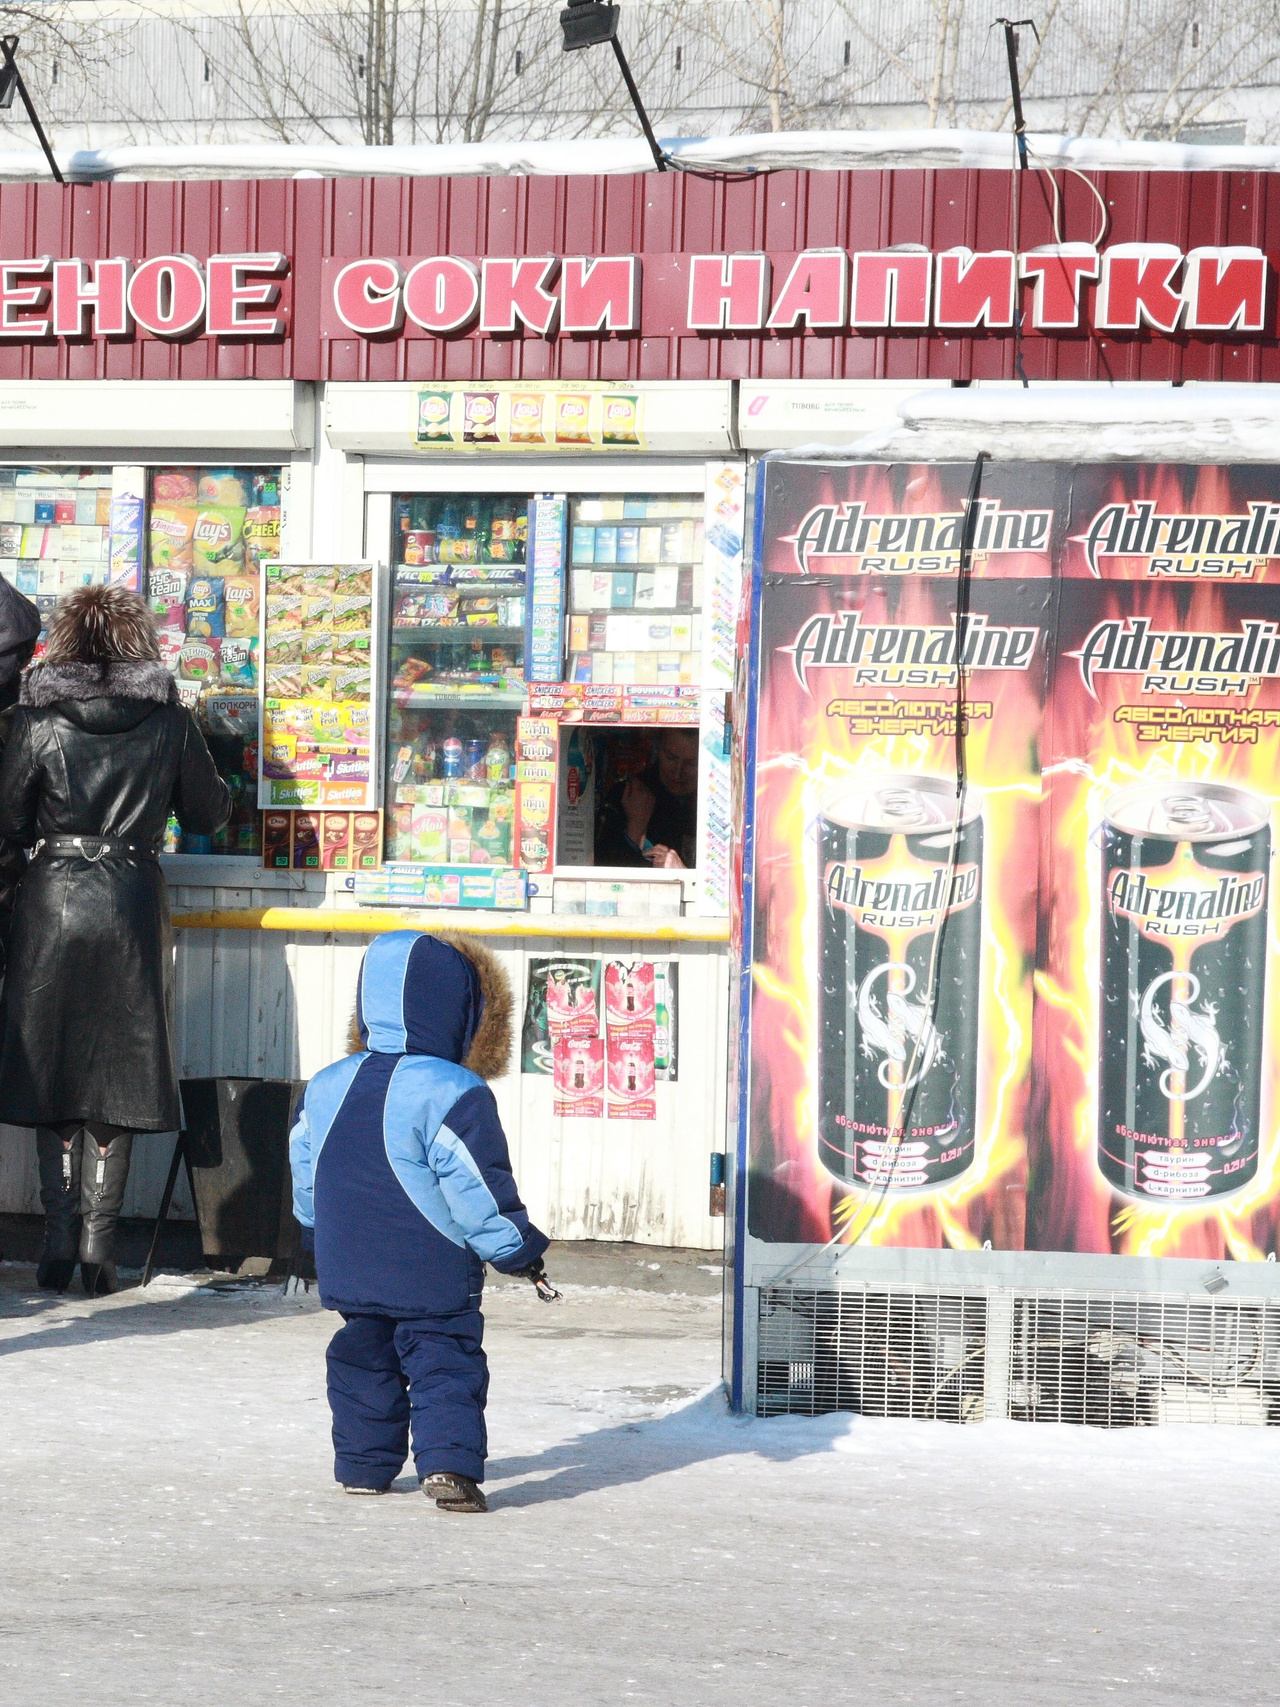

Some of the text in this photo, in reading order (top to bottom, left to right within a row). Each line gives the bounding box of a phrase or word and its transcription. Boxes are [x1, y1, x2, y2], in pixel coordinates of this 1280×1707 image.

[333, 246, 1267, 333] СОКИ НАПИТКИ
[791, 402, 820, 410] TUBORG
[788, 499, 1053, 572] Adrenaline
[1079, 503, 1280, 576] Adrenali
[112, 535, 138, 558] mentos
[861, 556, 971, 572] RUSH
[1150, 558, 1252, 575] RUSH
[150, 580, 180, 597] team
[189, 598, 212, 608] MAX
[223, 651, 246, 664] team
[786, 613, 1037, 690] Adrenaline
[1074, 620, 1280, 694] Adrenali
[856, 669, 956, 685] RUSH
[1144, 676, 1246, 692] RUSH
[434, 693, 461, 701] TUBORG
[533, 685, 563, 694] SNICKERS
[585, 686, 615, 695] SNICKERS
[212, 701, 257, 710] ПОПКОРН
[585, 699, 615, 708] SNICKERS
[827, 700, 992, 717] АБСОЛЮТНАЯ
[1115, 706, 1280, 726] АБСОЛЮТНАЯ
[851, 718, 969, 735] ЭНЕРГИЯ
[1138, 725, 1257, 743] ЭНЕРГИЯ
[280, 787, 314, 800] Skittles
[327, 788, 363, 801] Skittles
[415, 817, 444, 833] Мой
[826, 864, 978, 917] Adrenaline
[1109, 871, 1264, 924] Adrenaline
[862, 913, 935, 927] RUSH
[1145, 921, 1219, 936] RUSH
[1116, 1125, 1188, 1147] абсолютная
[1159, 1155, 1194, 1164] таурин
[1149, 1184, 1205, 1194] L-карнитин
